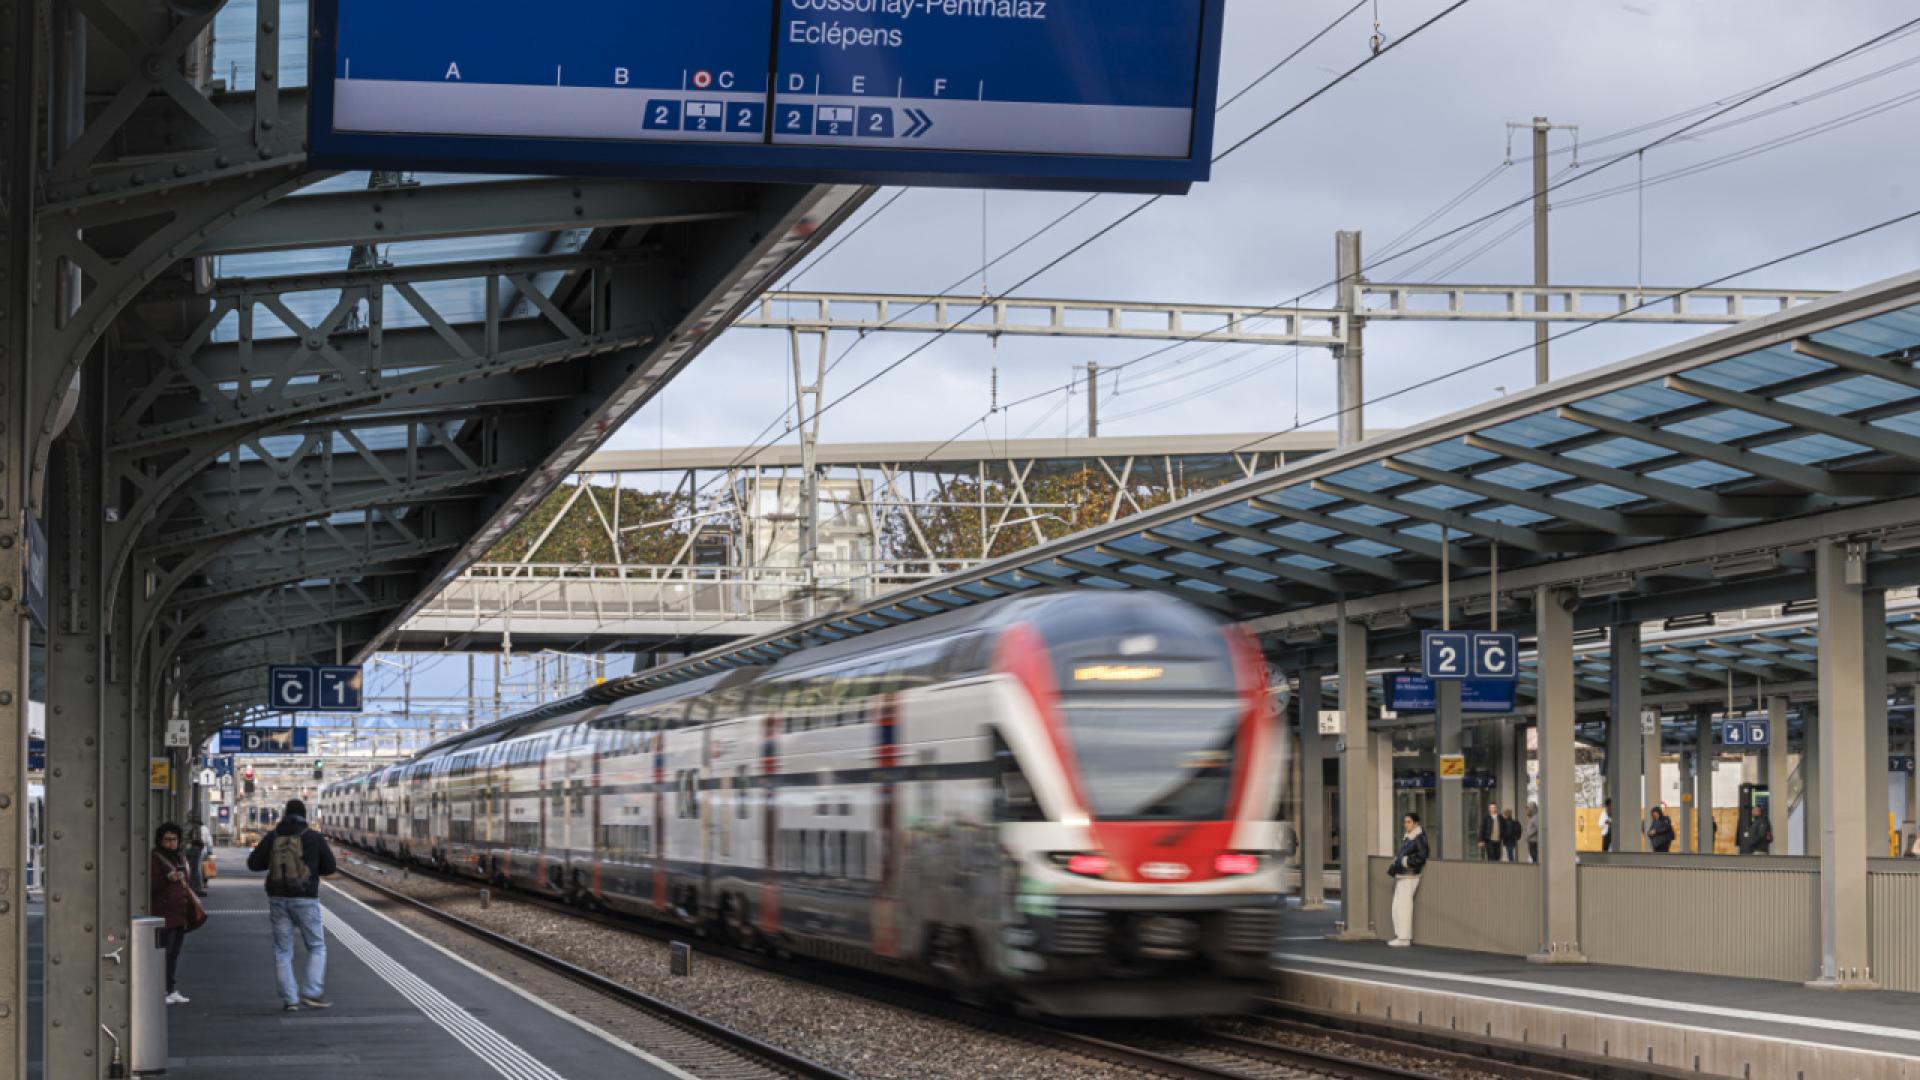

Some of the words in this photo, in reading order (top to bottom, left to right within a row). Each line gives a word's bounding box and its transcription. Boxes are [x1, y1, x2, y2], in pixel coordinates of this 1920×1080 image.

[789, 20, 903, 51] Eclépens
[445, 62, 461, 80] A
[614, 68, 629, 86] B
[719, 71, 735, 88] C
[788, 73, 805, 91] D
[852, 75, 865, 94] E
[934, 78, 948, 96] F
[655, 105, 669, 124] 2
[698, 104, 706, 115] 1
[737, 108, 752, 127] 2
[831, 109, 838, 119] 1
[697, 118, 707, 130] 2
[786, 110, 801, 129] 2
[829, 122, 839, 134] 2
[869, 113, 883, 131] 2
[1438, 646, 1456, 673] 2
[1483, 646, 1506, 673] C
[281, 680, 304, 705] C
[332, 680, 345, 705] 1
[248, 735, 260, 749] D
[1728, 728, 1739, 742] 4
[1751, 728, 1765, 742] D
